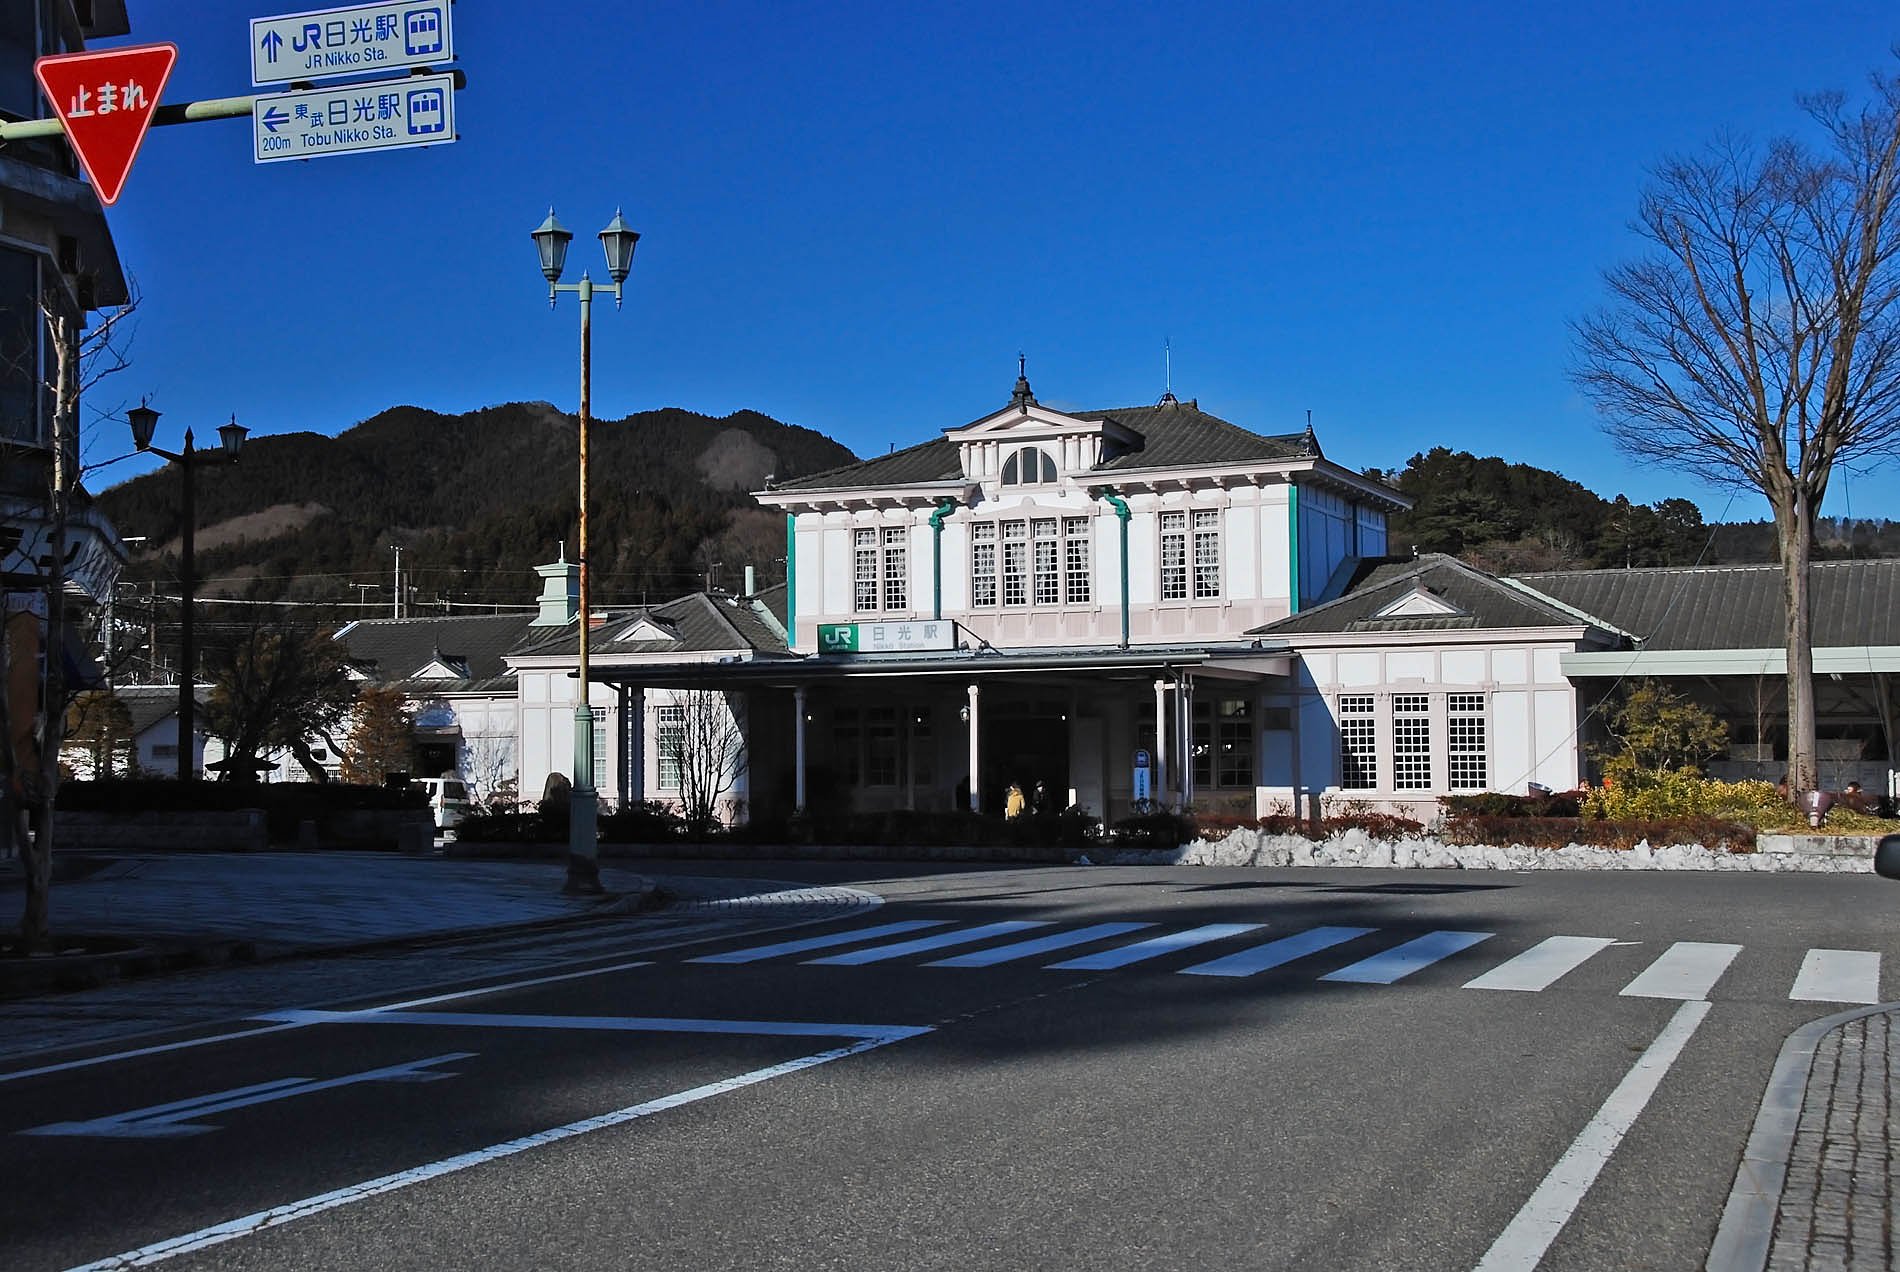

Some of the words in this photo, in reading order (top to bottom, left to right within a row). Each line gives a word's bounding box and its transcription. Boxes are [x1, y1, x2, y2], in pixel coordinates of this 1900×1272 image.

[292, 14, 399, 52] JR日光駅
[305, 54, 322, 69] JR
[325, 50, 360, 67] Nikko
[364, 47, 388, 62] Sta.
[67, 78, 149, 118] 止まれ
[262, 136, 291, 151] 200m
[301, 132, 331, 148] Tobu
[334, 128, 369, 145] Nikko
[372, 125, 397, 139] Sta.
[825, 627, 852, 644] JR
[873, 624, 938, 641] 日光駅
